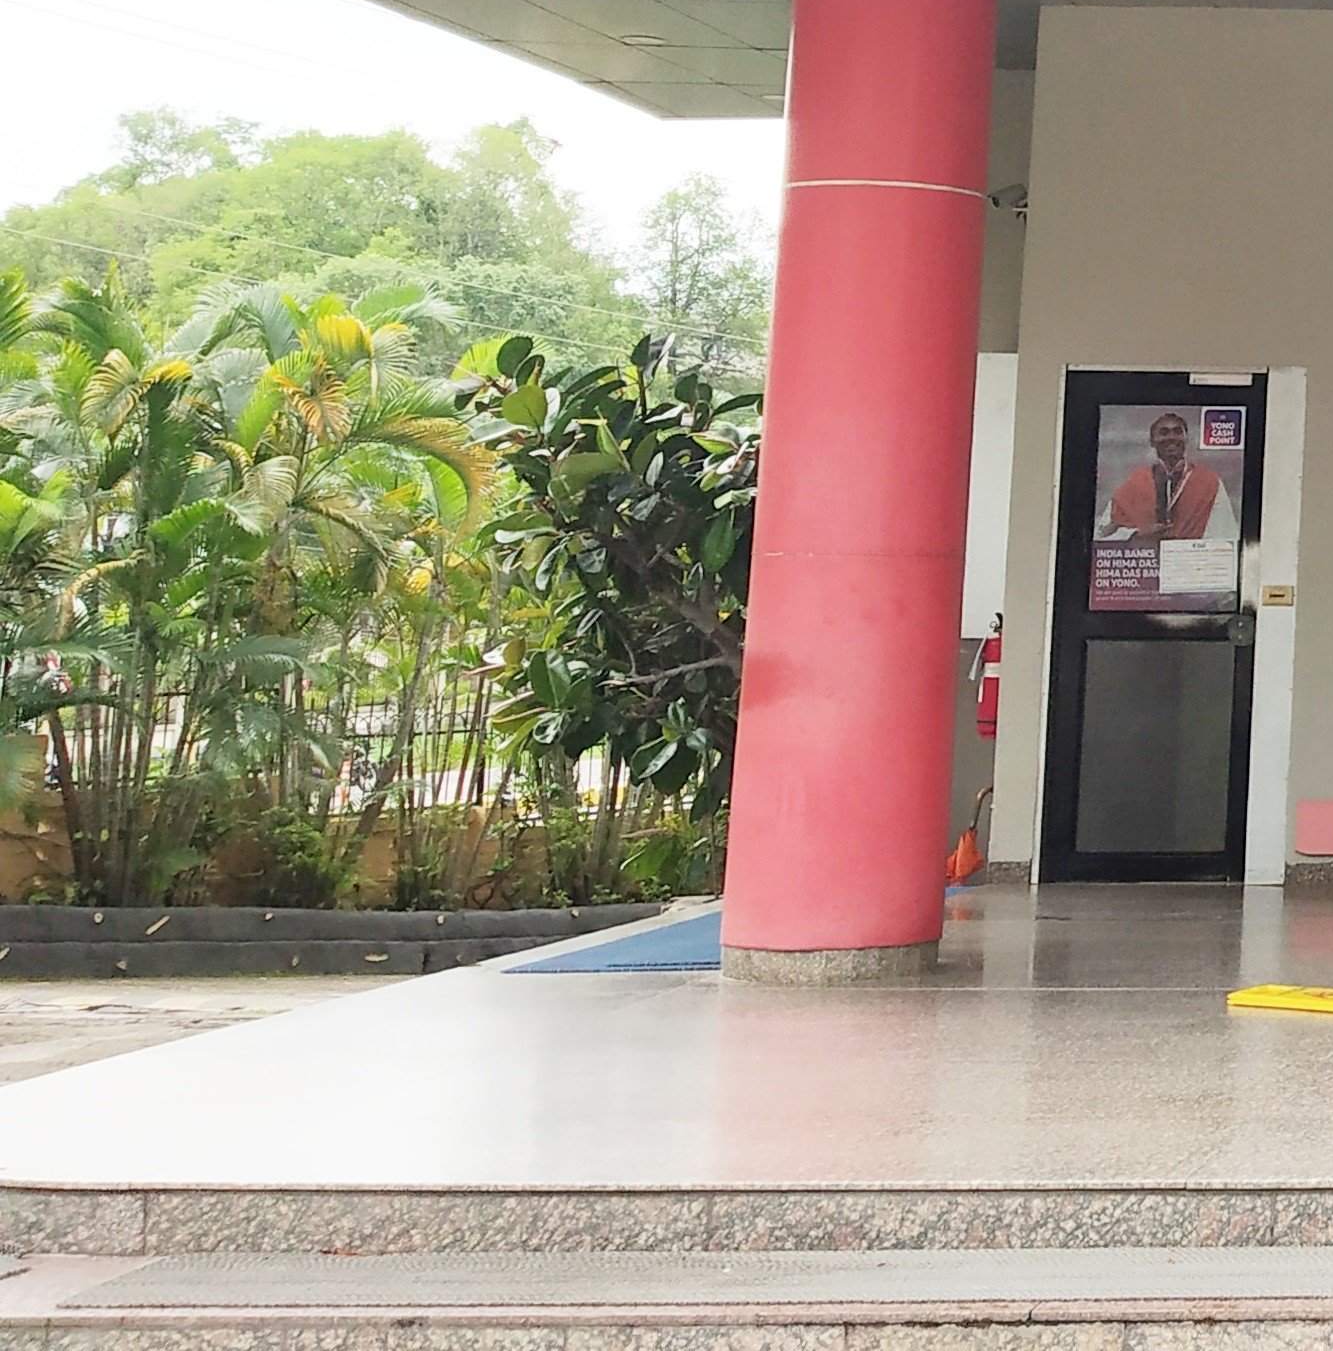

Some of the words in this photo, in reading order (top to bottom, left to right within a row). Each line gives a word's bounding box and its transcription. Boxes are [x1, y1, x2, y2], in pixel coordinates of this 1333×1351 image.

[1096, 549, 1122, 558] INDIA
[1124, 549, 1155, 558] BANKS
[1096, 559, 1110, 567] ON
[1112, 559, 1137, 567] HIMA
[1095, 569, 1120, 577] HIMA
[1122, 569, 1141, 577] DAS
[1095, 579, 1109, 587] ON
